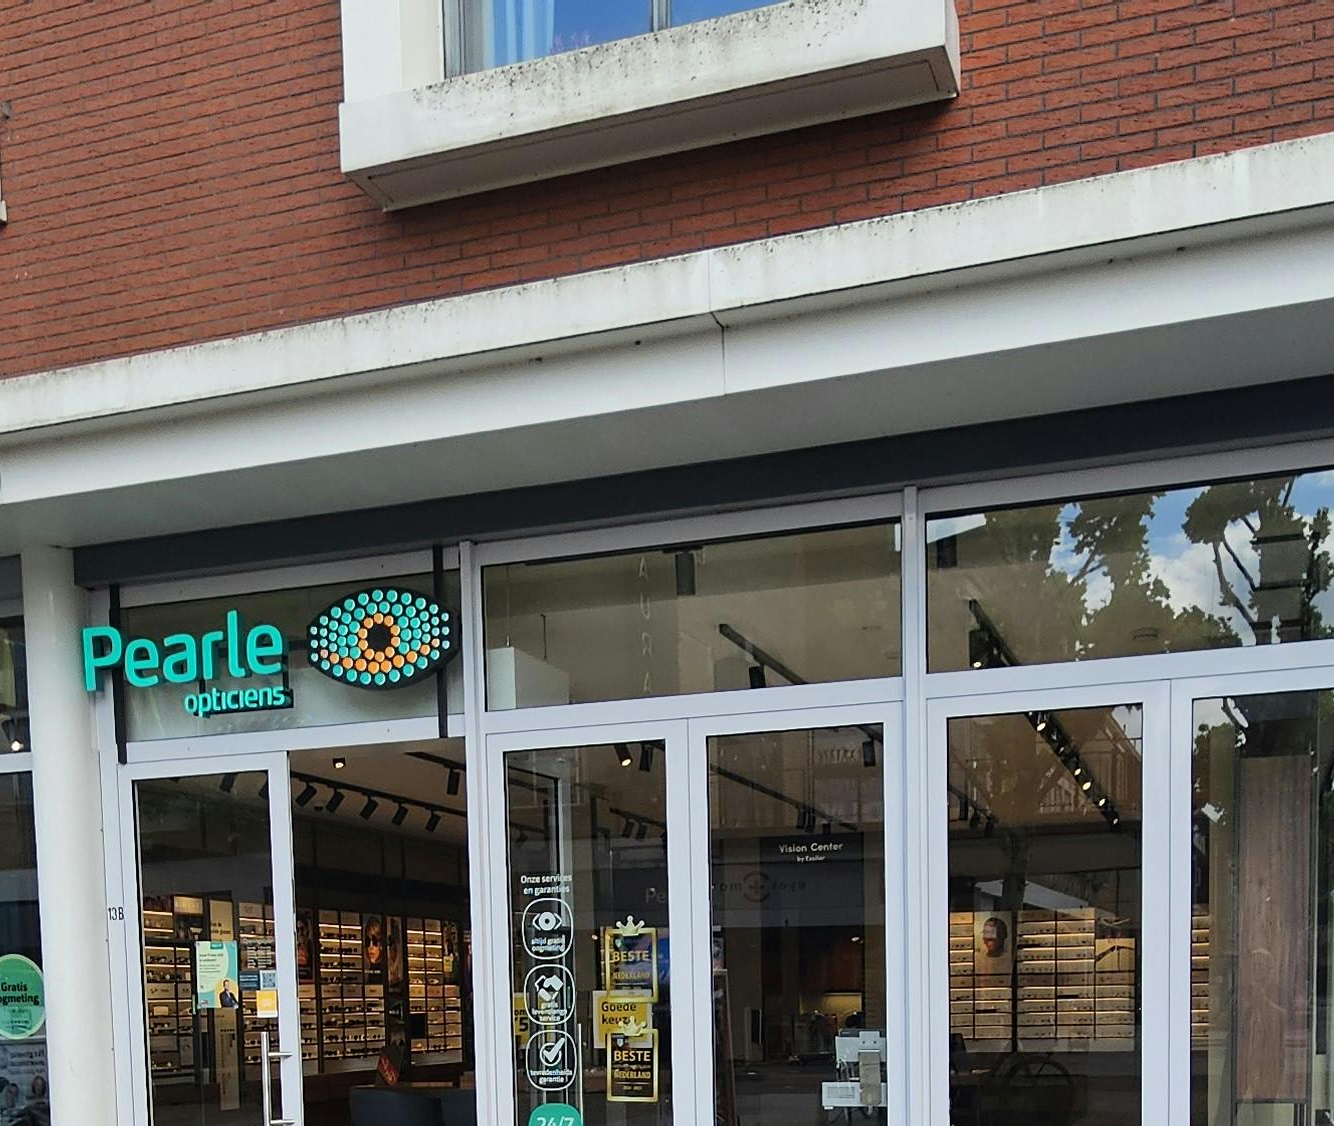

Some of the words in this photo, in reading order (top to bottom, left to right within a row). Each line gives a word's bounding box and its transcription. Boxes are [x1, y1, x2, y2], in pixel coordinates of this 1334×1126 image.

[81, 609, 284, 692] Pearle
[184, 686, 286, 718] opticiens
[779, 844, 808, 853] Vision
[811, 842, 843, 852] Center
[520, 875, 541, 884] Onze
[541, 873, 573, 883] services
[523, 887, 533, 895] en
[107, 907, 124, 921] 13B
[613, 951, 649, 962] BESTE
[0, 981, 28, 993] Gratis
[601, 1001, 637, 1012] Goede
[613, 1050, 651, 1062] BESTE
